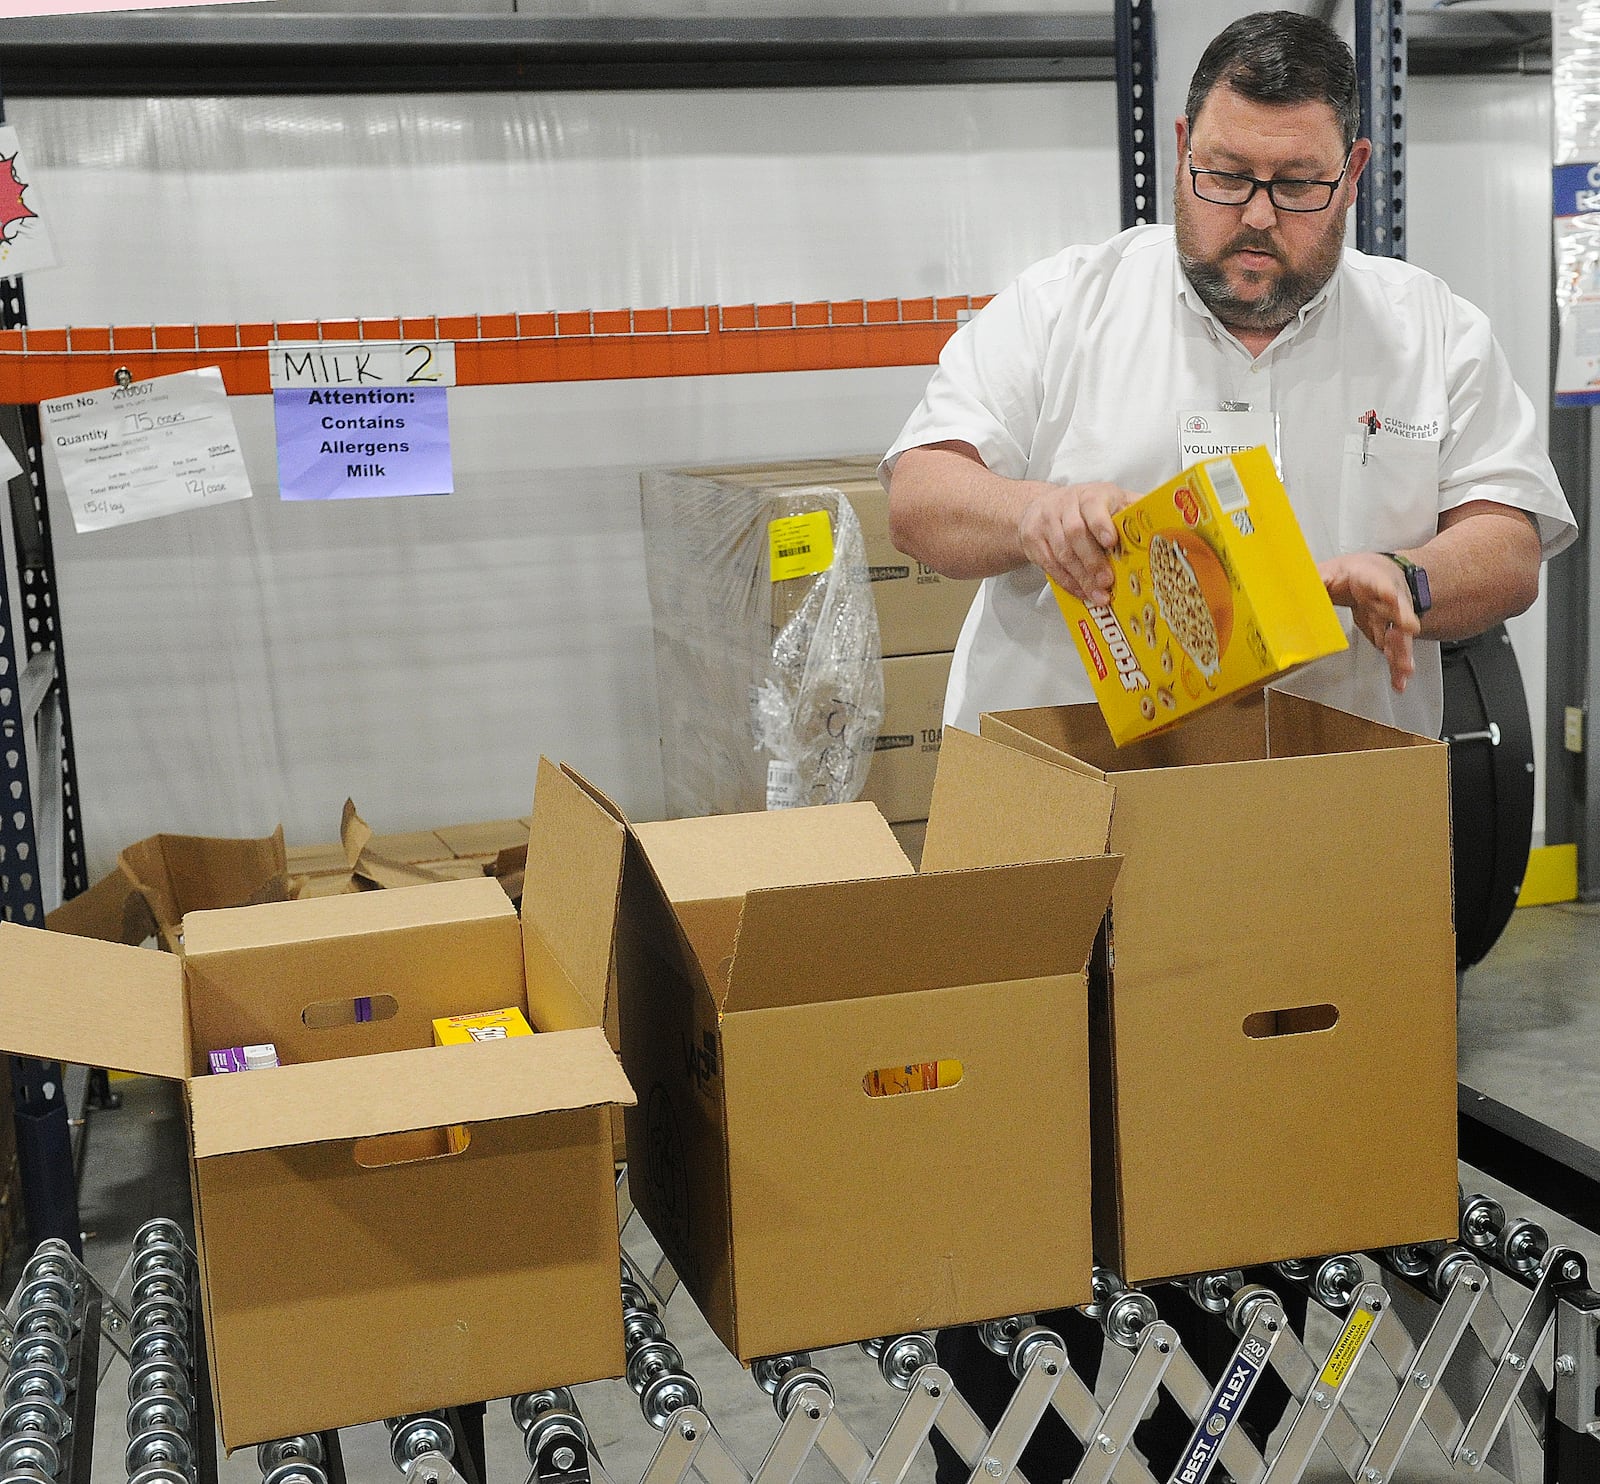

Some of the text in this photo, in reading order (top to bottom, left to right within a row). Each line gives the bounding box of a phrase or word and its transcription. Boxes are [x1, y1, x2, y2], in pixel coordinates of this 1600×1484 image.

[285, 345, 440, 384] MILK 2
[46, 402, 74, 414] Item
[76, 397, 98, 407] No.
[308, 389, 415, 405] Attention:
[124, 411, 154, 430] 75
[321, 416, 405, 429] Contains
[1384, 417, 1438, 432] CUSHMAN &
[56, 429, 108, 447] Quantity
[1384, 425, 1439, 439] WAKEFIELD
[319, 441, 410, 456] Allergens
[347, 464, 386, 477] Milk
[1245, 1339, 1265, 1358] 200
[1335, 1324, 1357, 1360] WARNING
[1180, 1438, 1211, 1484] BEST
[1218, 1365, 1250, 1411] FLEX
